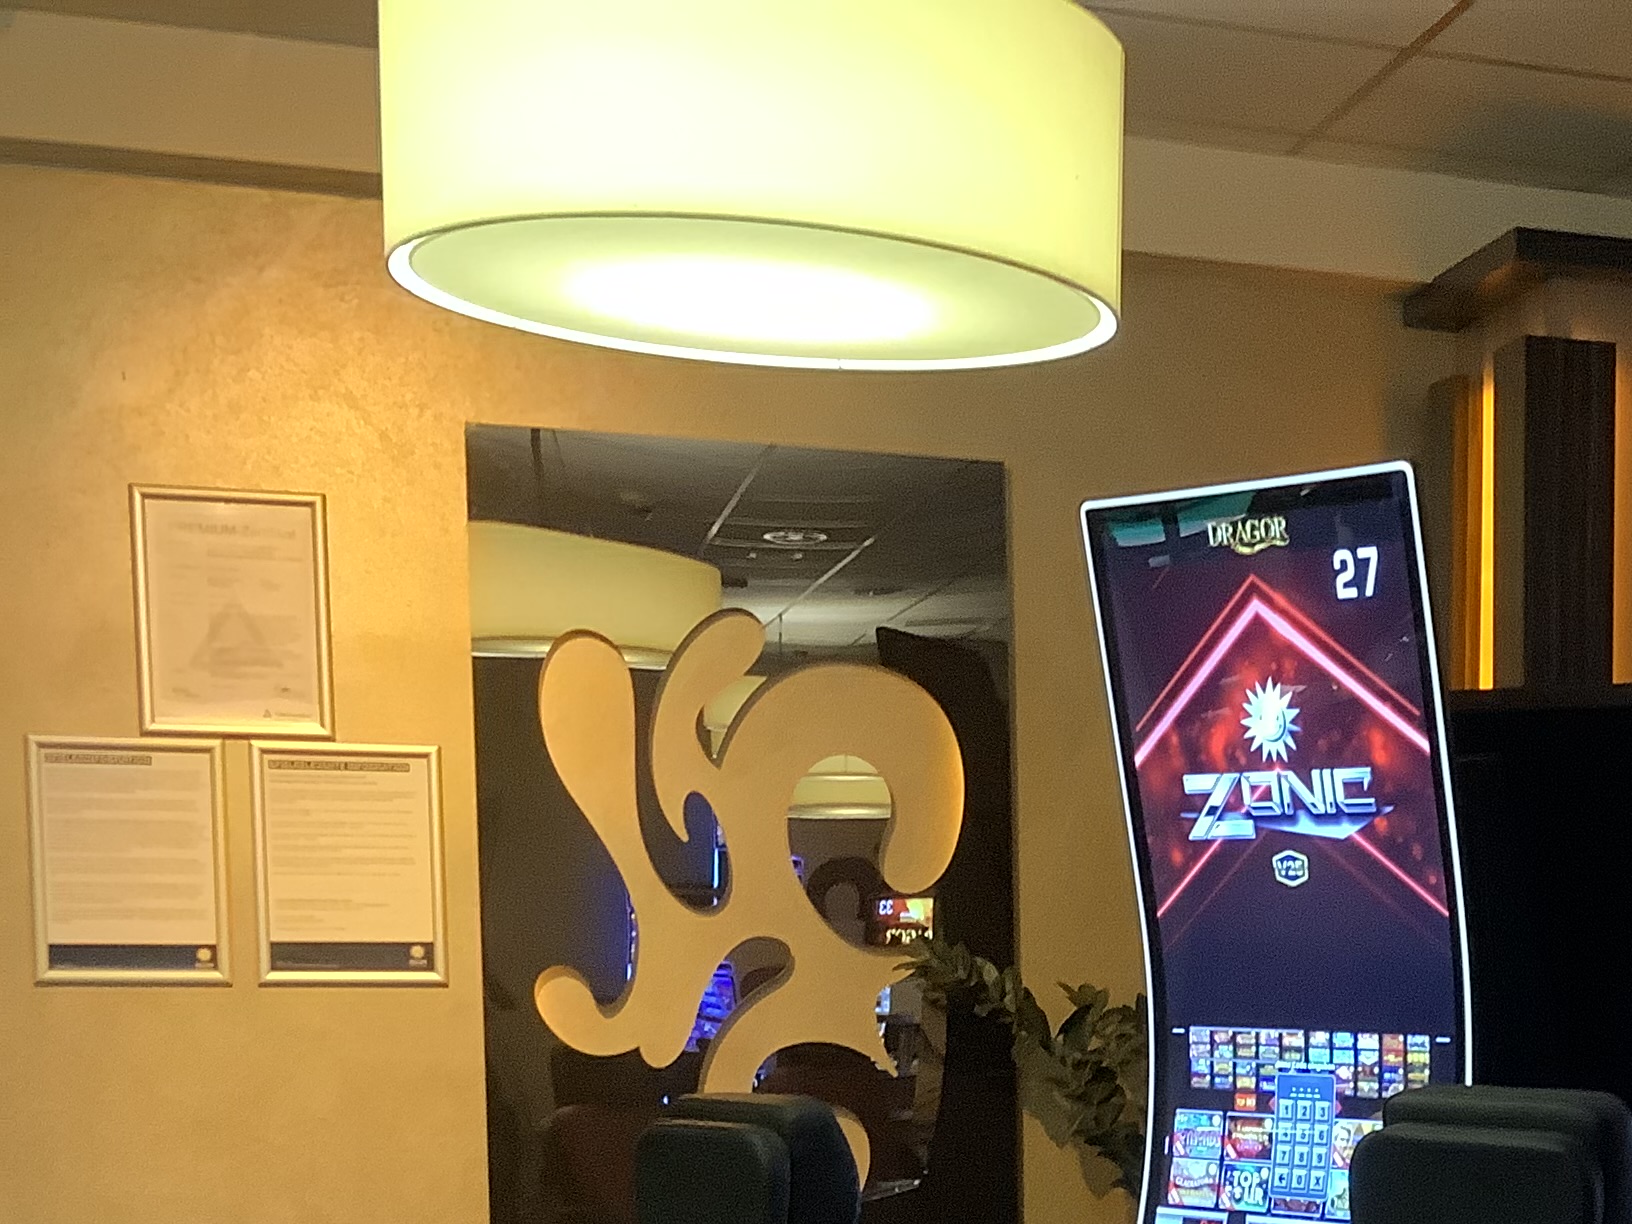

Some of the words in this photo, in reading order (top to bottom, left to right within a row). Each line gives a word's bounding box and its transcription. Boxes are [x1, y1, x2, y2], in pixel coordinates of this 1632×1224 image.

[1207, 516, 1288, 547] DRAGOR
[1332, 546, 1378, 600] 27
[1182, 767, 1377, 841] ZONIC
[1233, 1171, 1260, 1188] TOP
